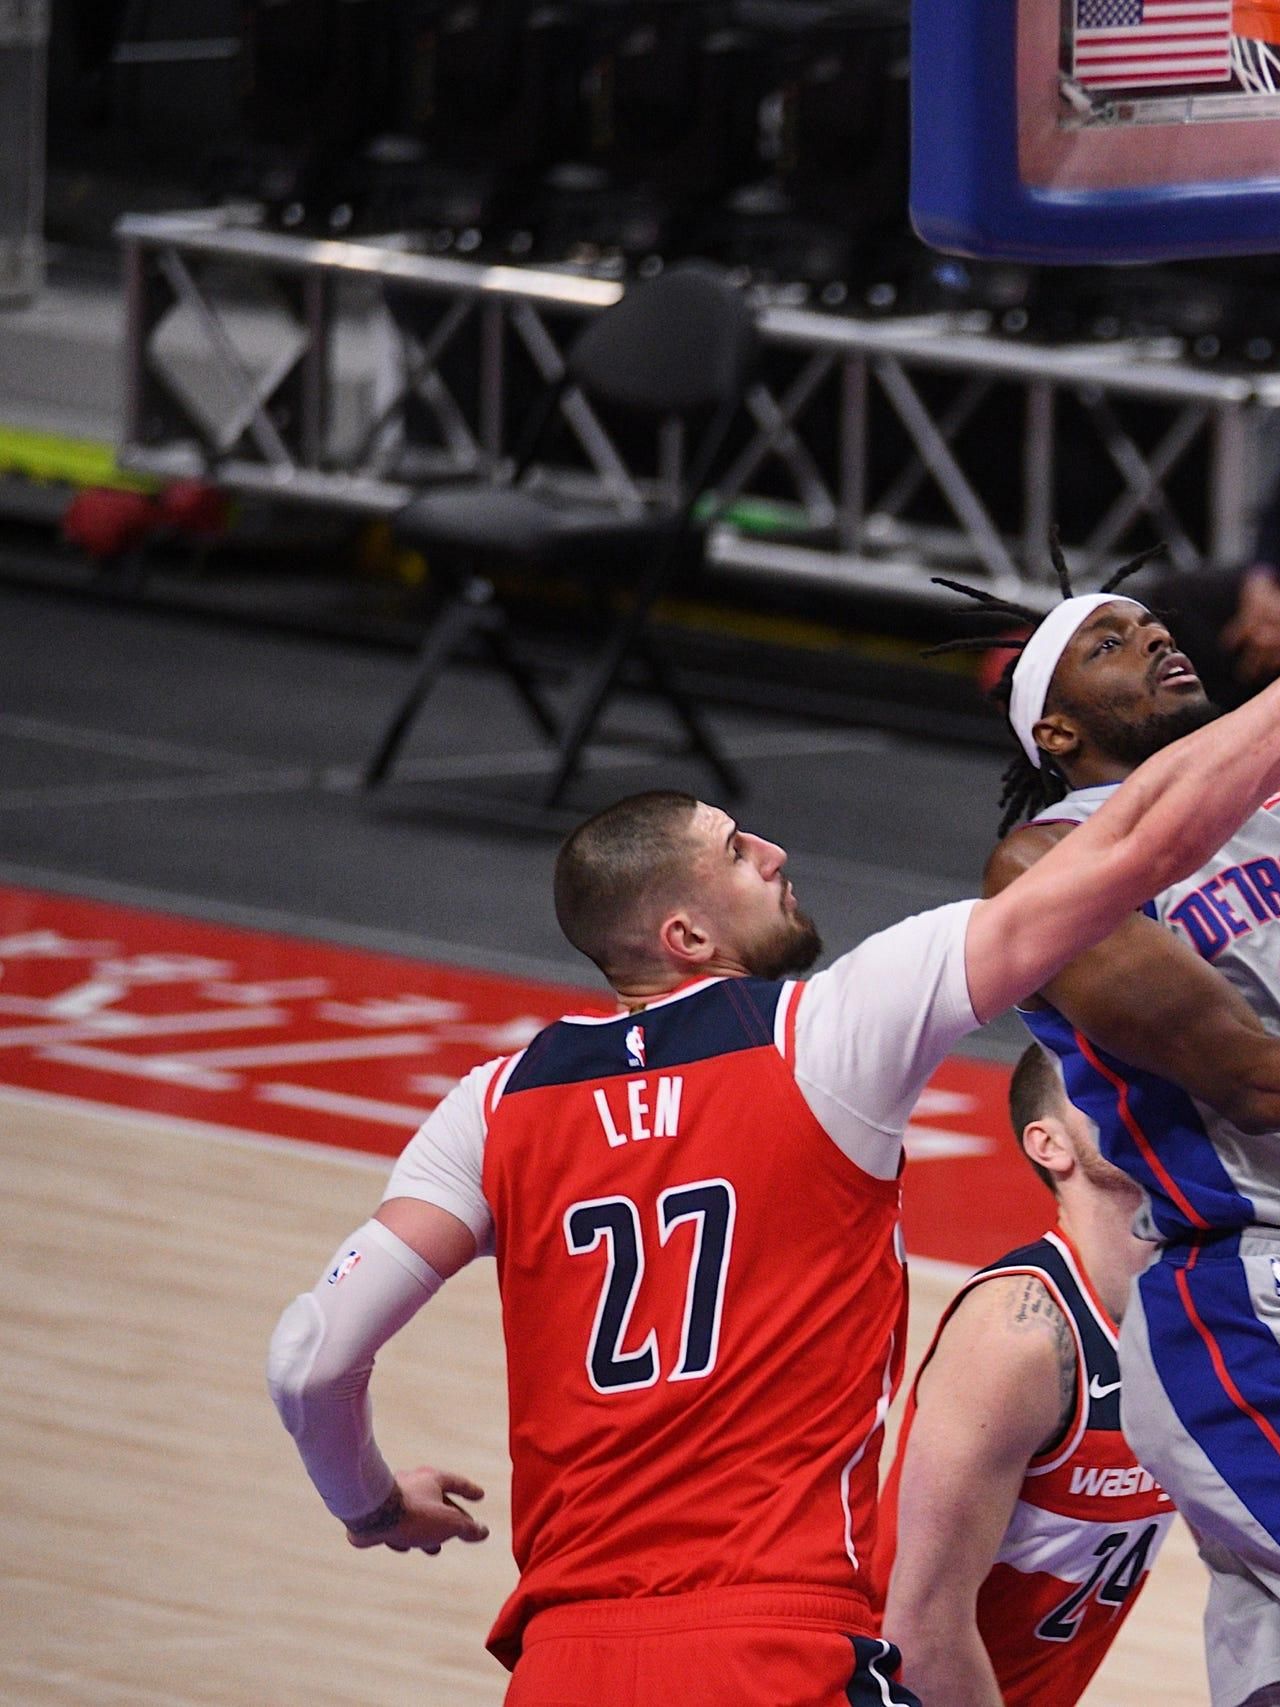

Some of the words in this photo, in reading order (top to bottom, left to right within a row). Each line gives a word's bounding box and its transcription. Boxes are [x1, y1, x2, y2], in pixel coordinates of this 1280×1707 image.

[593, 1075, 683, 1148] LEN
[563, 1177, 736, 1395] 27
[1034, 1522, 1159, 1642] 24
